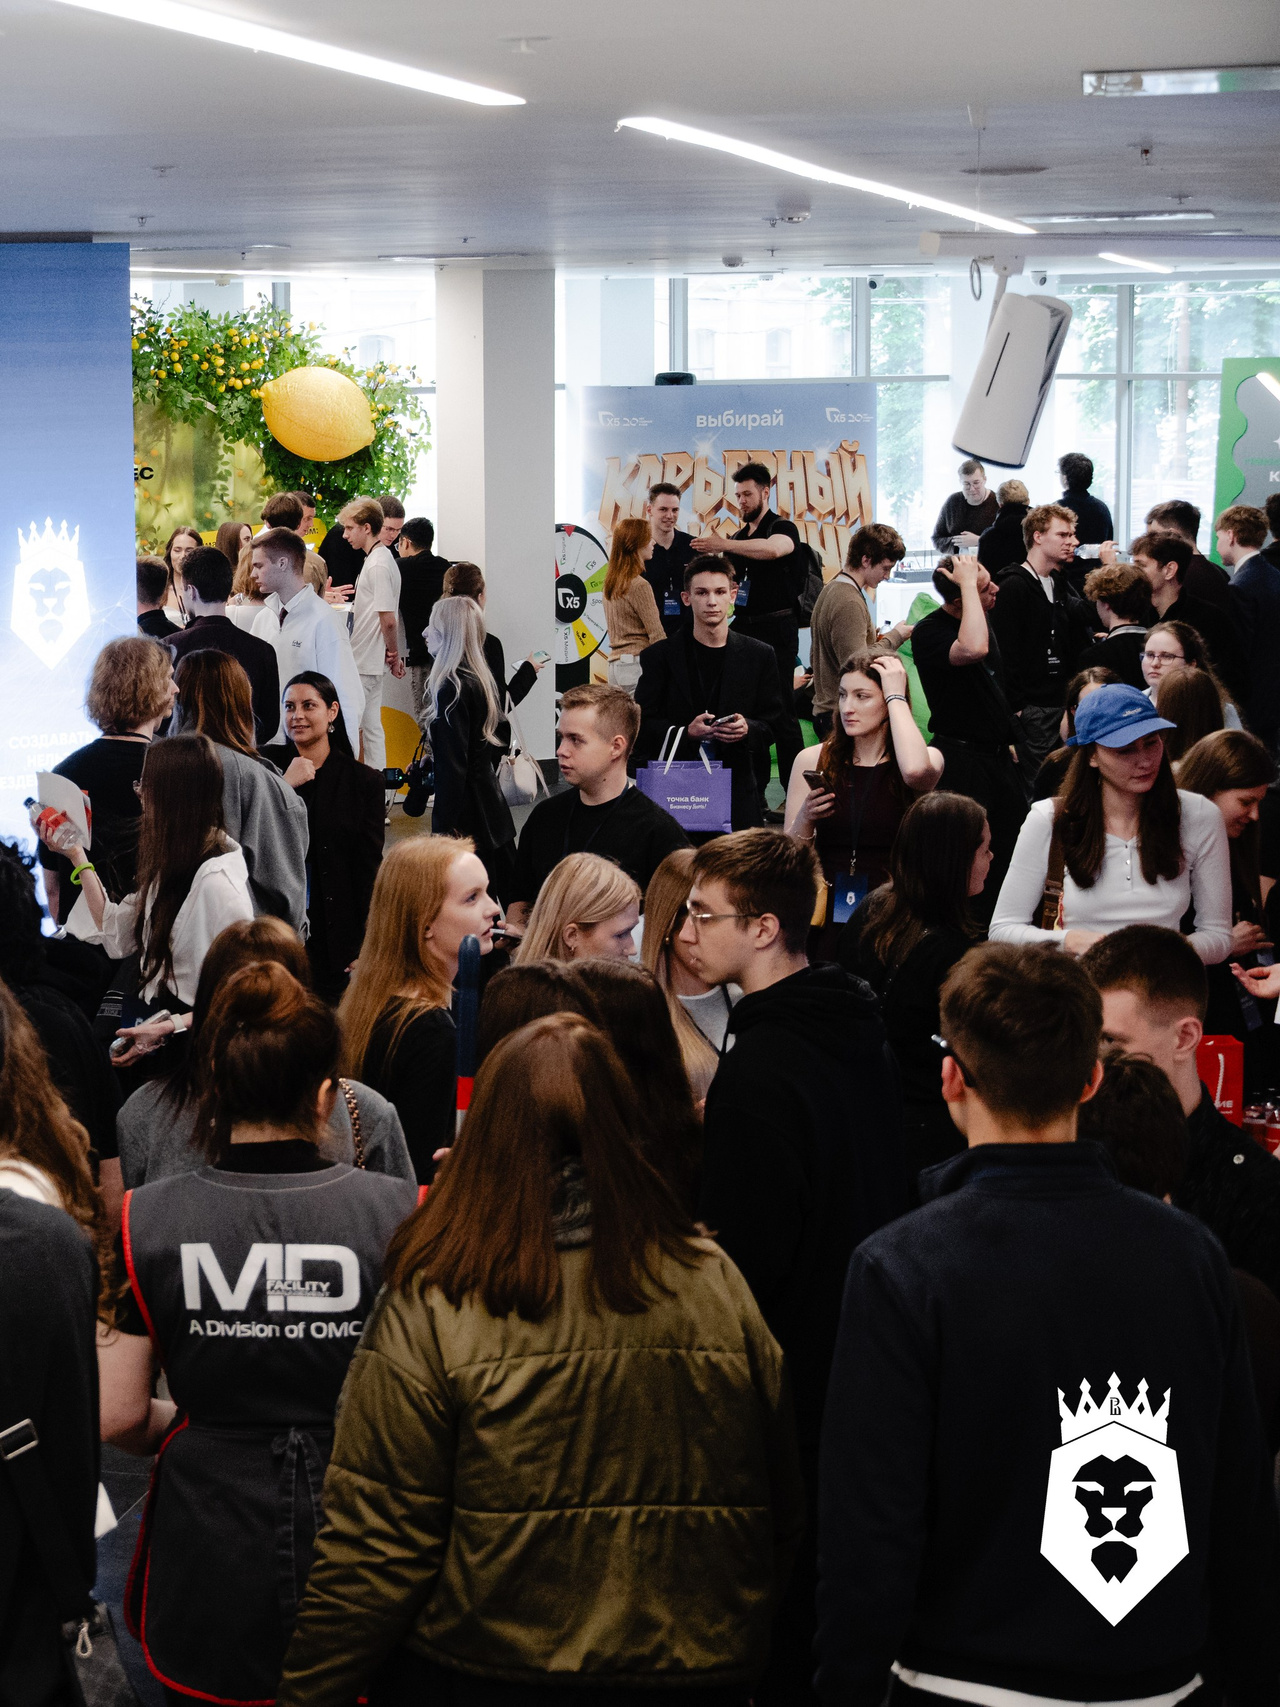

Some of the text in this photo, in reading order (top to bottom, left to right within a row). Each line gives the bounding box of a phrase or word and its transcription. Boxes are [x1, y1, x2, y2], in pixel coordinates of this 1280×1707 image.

[696, 409, 784, 430] выбирай
[565, 596, 580, 609] X5
[8, 730, 94, 750] СОЗДАВАТЬ
[26, 751, 70, 768] НЕЛЬ
[180, 1242, 361, 1313] MD
[267, 1280, 330, 1292] FACILITY
[189, 1319, 363, 1339] A Division of OMC
